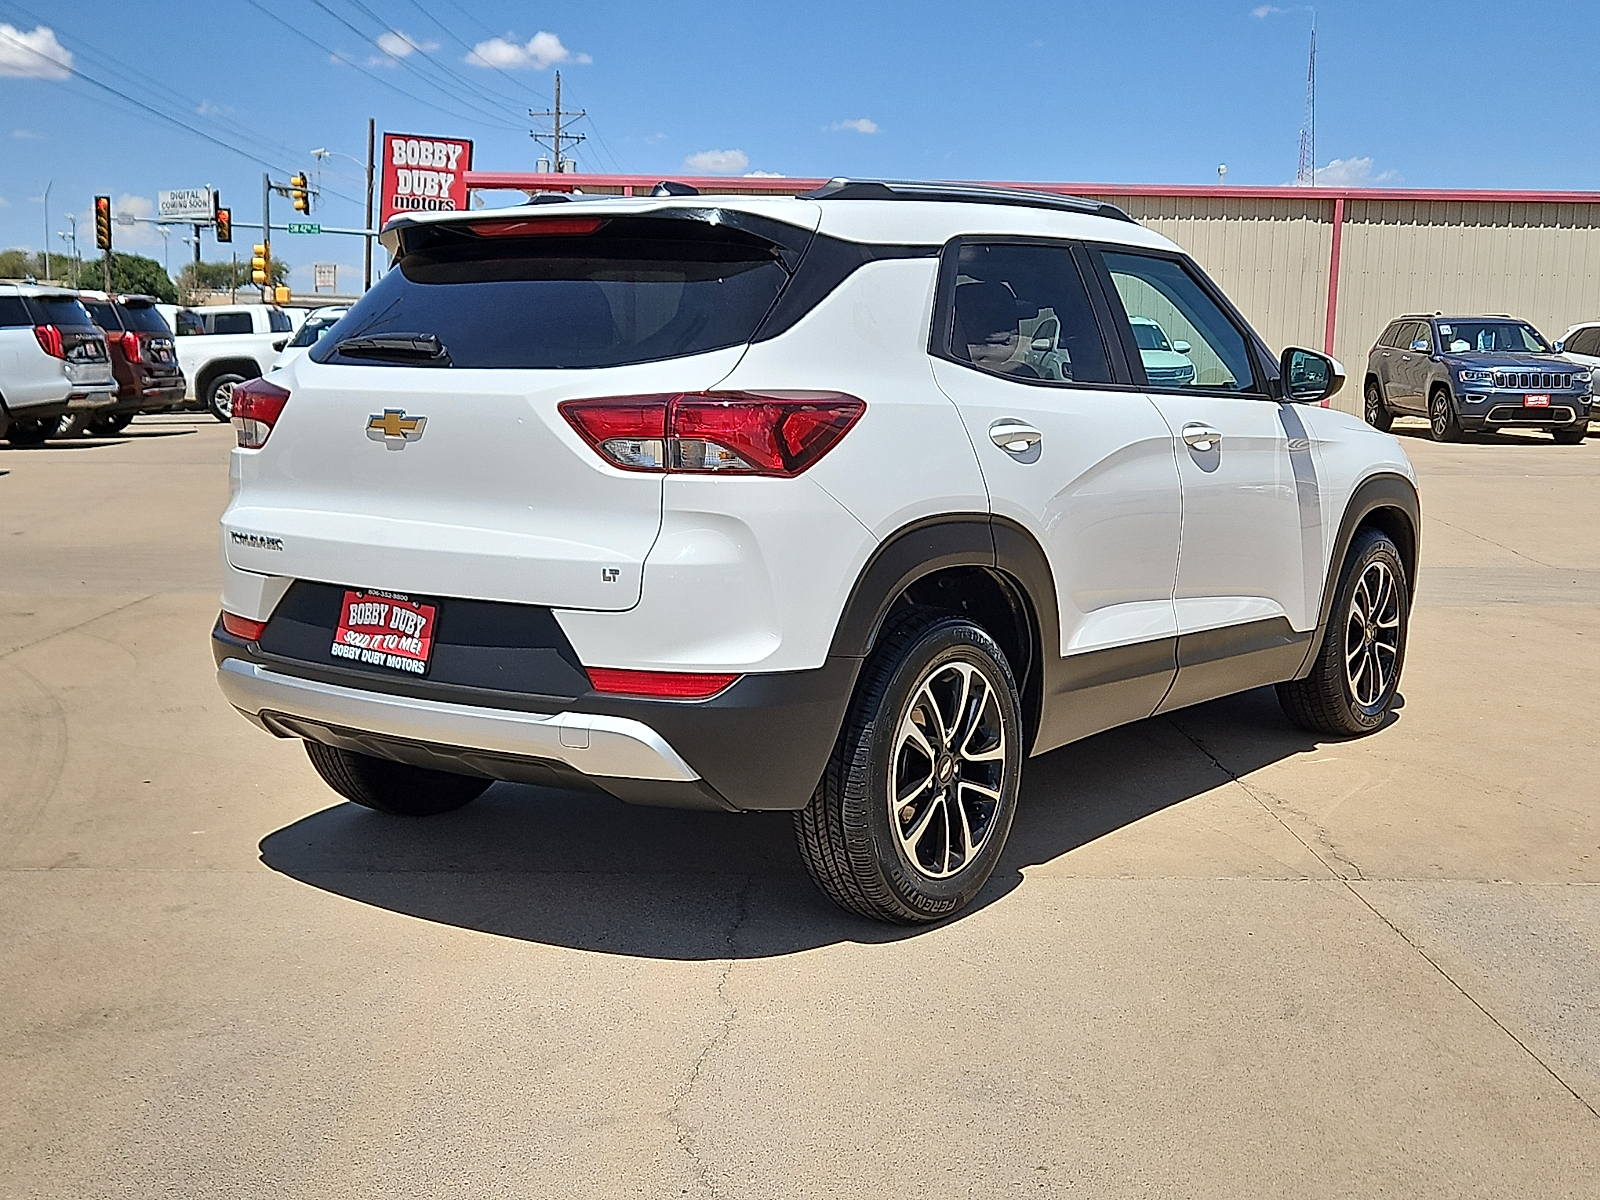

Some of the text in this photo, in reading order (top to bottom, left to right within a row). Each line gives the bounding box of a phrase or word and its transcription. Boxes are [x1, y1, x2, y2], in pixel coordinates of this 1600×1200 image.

[391, 139, 463, 170] BOBBY
[170, 190, 200, 200] DIGITAL
[397, 169, 455, 198] DUBY
[161, 200, 207, 209] COMING SOON
[393, 195, 455, 211] motors
[602, 568, 620, 583] LT
[348, 602, 427, 638] BOBBY DUBY
[343, 631, 424, 656] SOLD IT TO ME!
[331, 643, 426, 675] BOBBY DUBY MOTORS
